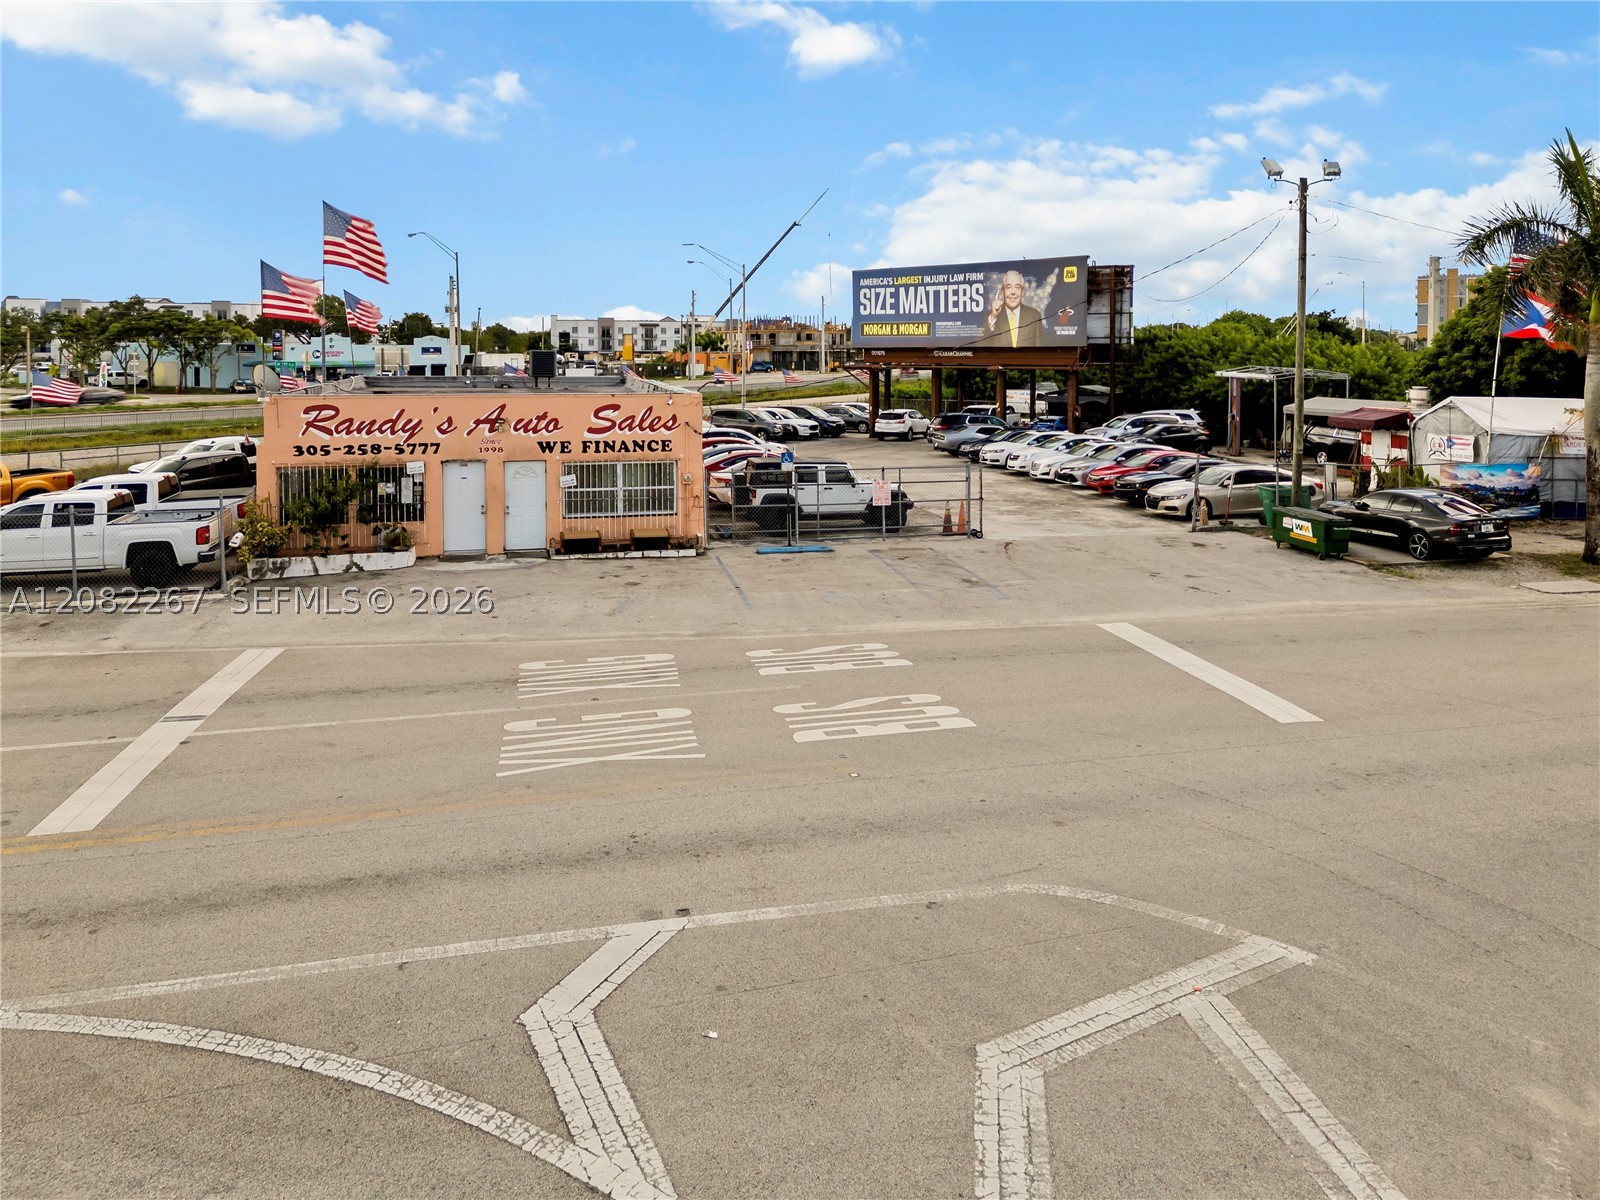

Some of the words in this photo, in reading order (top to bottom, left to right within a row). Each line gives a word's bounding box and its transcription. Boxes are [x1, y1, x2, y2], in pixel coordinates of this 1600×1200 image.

[860, 277, 893, 286] AMERICA'S
[893, 275, 923, 285] LARGEST
[923, 274, 948, 284] INJURY
[949, 273, 965, 283] LAW
[965, 272, 984, 281] FIRM
[859, 287, 896, 316] SIZE
[899, 283, 984, 314] MATTERS
[863, 323, 891, 336] MORGAN
[892, 324, 898, 335] &
[898, 322, 928, 335] MORGAN
[299, 403, 458, 445] Randy's
[463, 403, 563, 438] Auto
[583, 403, 681, 439] Sales
[479, 437, 503, 446] Since
[536, 440, 573, 454] WE
[581, 439, 673, 454] FINANCE
[292, 442, 441, 457] 305-258-5777
[478, 446, 504, 454] 1998
[1294, 522, 1310, 533] WM
[772, 693, 976, 743] BUS
[495, 707, 706, 778] XING
